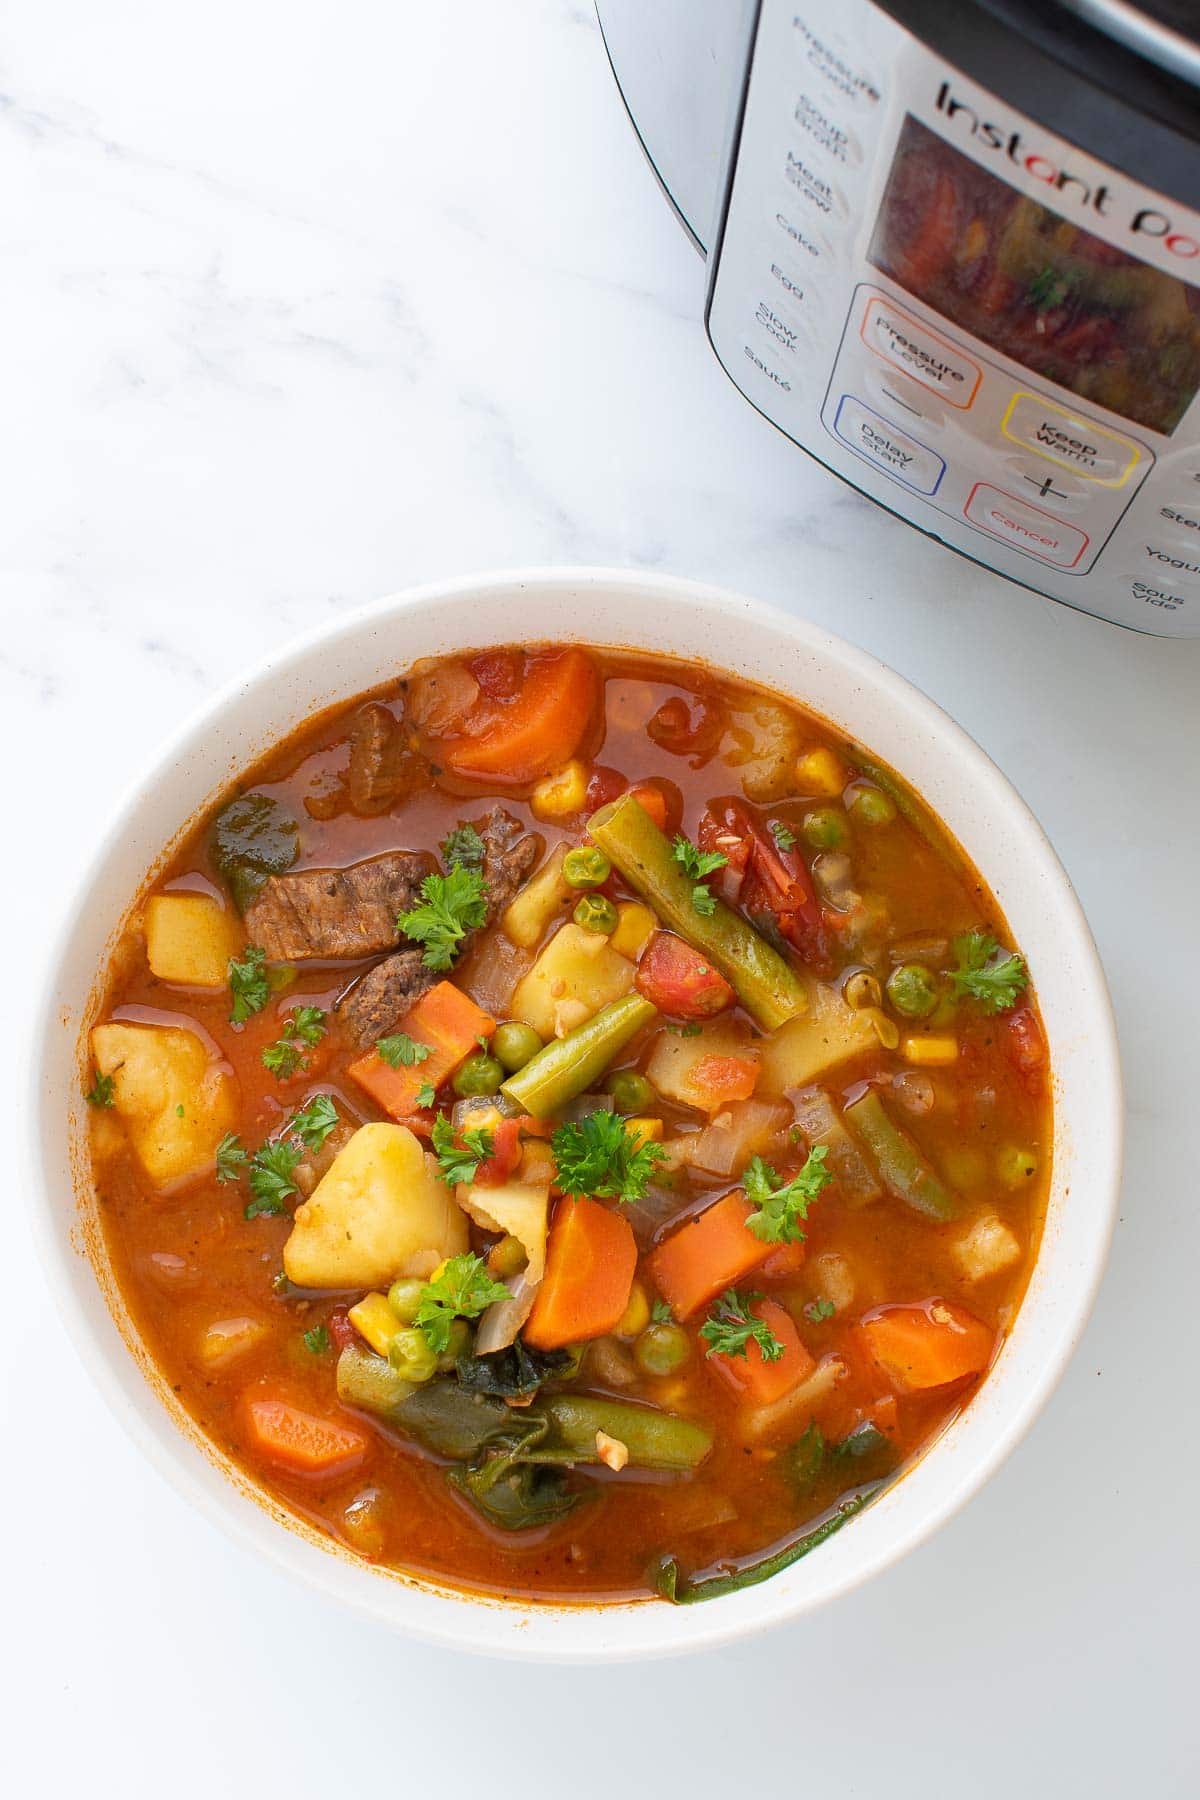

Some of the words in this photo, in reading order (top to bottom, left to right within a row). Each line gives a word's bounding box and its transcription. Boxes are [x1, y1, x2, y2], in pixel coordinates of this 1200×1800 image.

[934, 81, 1111, 217] Instant
[785, 167, 831, 213] Stew
[787, 151, 832, 199] Meat
[776, 213, 819, 256] Cake
[771, 263, 804, 300] Egg
[755, 311, 797, 353] Cook
[759, 302, 798, 340] Slow
[744, 346, 792, 391] Sauté
[876, 317, 965, 382] Pressure
[890, 341, 943, 382] Level
[860, 423, 913, 462] Delay
[860, 434, 907, 470] Start
[1036, 431, 1096, 466] Warm
[1041, 422, 1097, 456] Keep
[991, 511, 1059, 548] Cancel
[1160, 507, 1200, 531] Ste
[1145, 545, 1200, 574] Yogu
[1131, 590, 1177, 610] Vide
[1132, 582, 1185, 605] Sous
